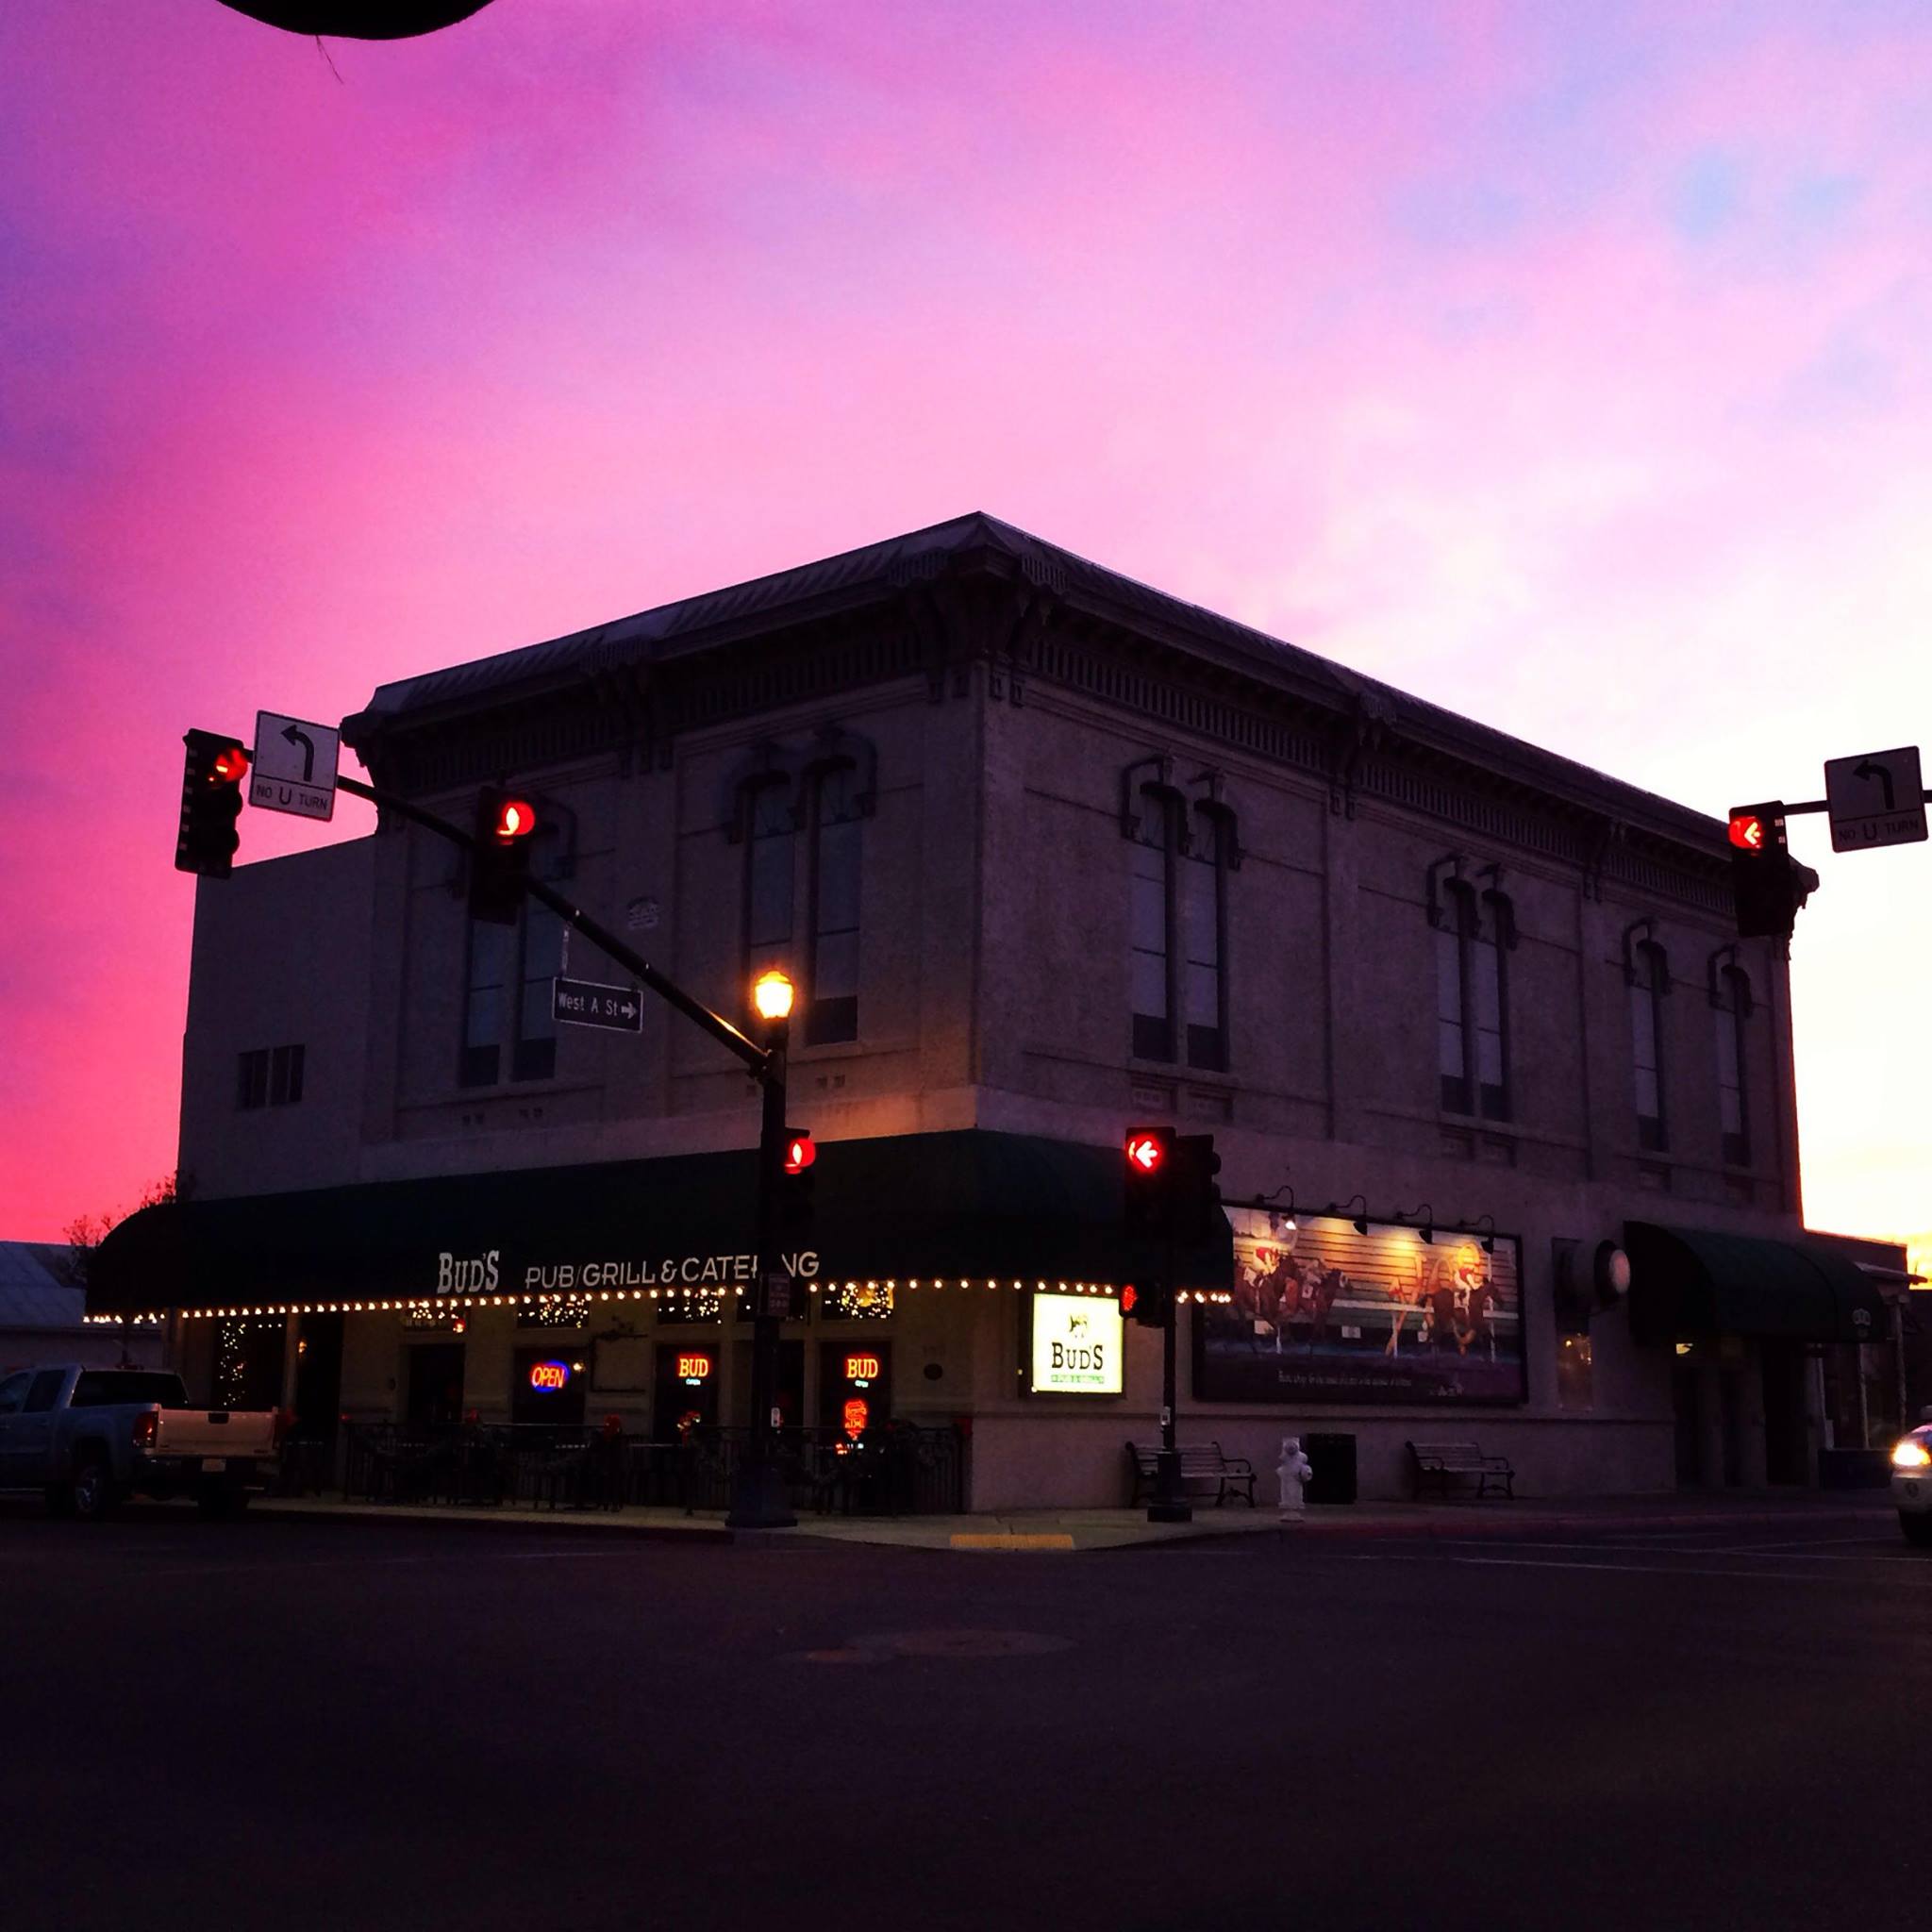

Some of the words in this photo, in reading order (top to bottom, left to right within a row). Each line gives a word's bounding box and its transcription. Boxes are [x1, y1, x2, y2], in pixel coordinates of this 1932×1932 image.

[256, 784, 273, 799] NO
[278, 786, 292, 806] U
[298, 792, 328, 811] TURN
[1838, 828, 1857, 843] NO
[1862, 822, 1877, 841] U
[1884, 818, 1919, 835] TURN
[558, 991, 586, 1012] West
[591, 996, 600, 1014] A
[605, 998, 619, 1017] St
[681, 1250, 820, 1283] CATENG
[531, 1366, 565, 1389] OPEN
[678, 1357, 708, 1377] BUD
[846, 1357, 878, 1378] BUD
